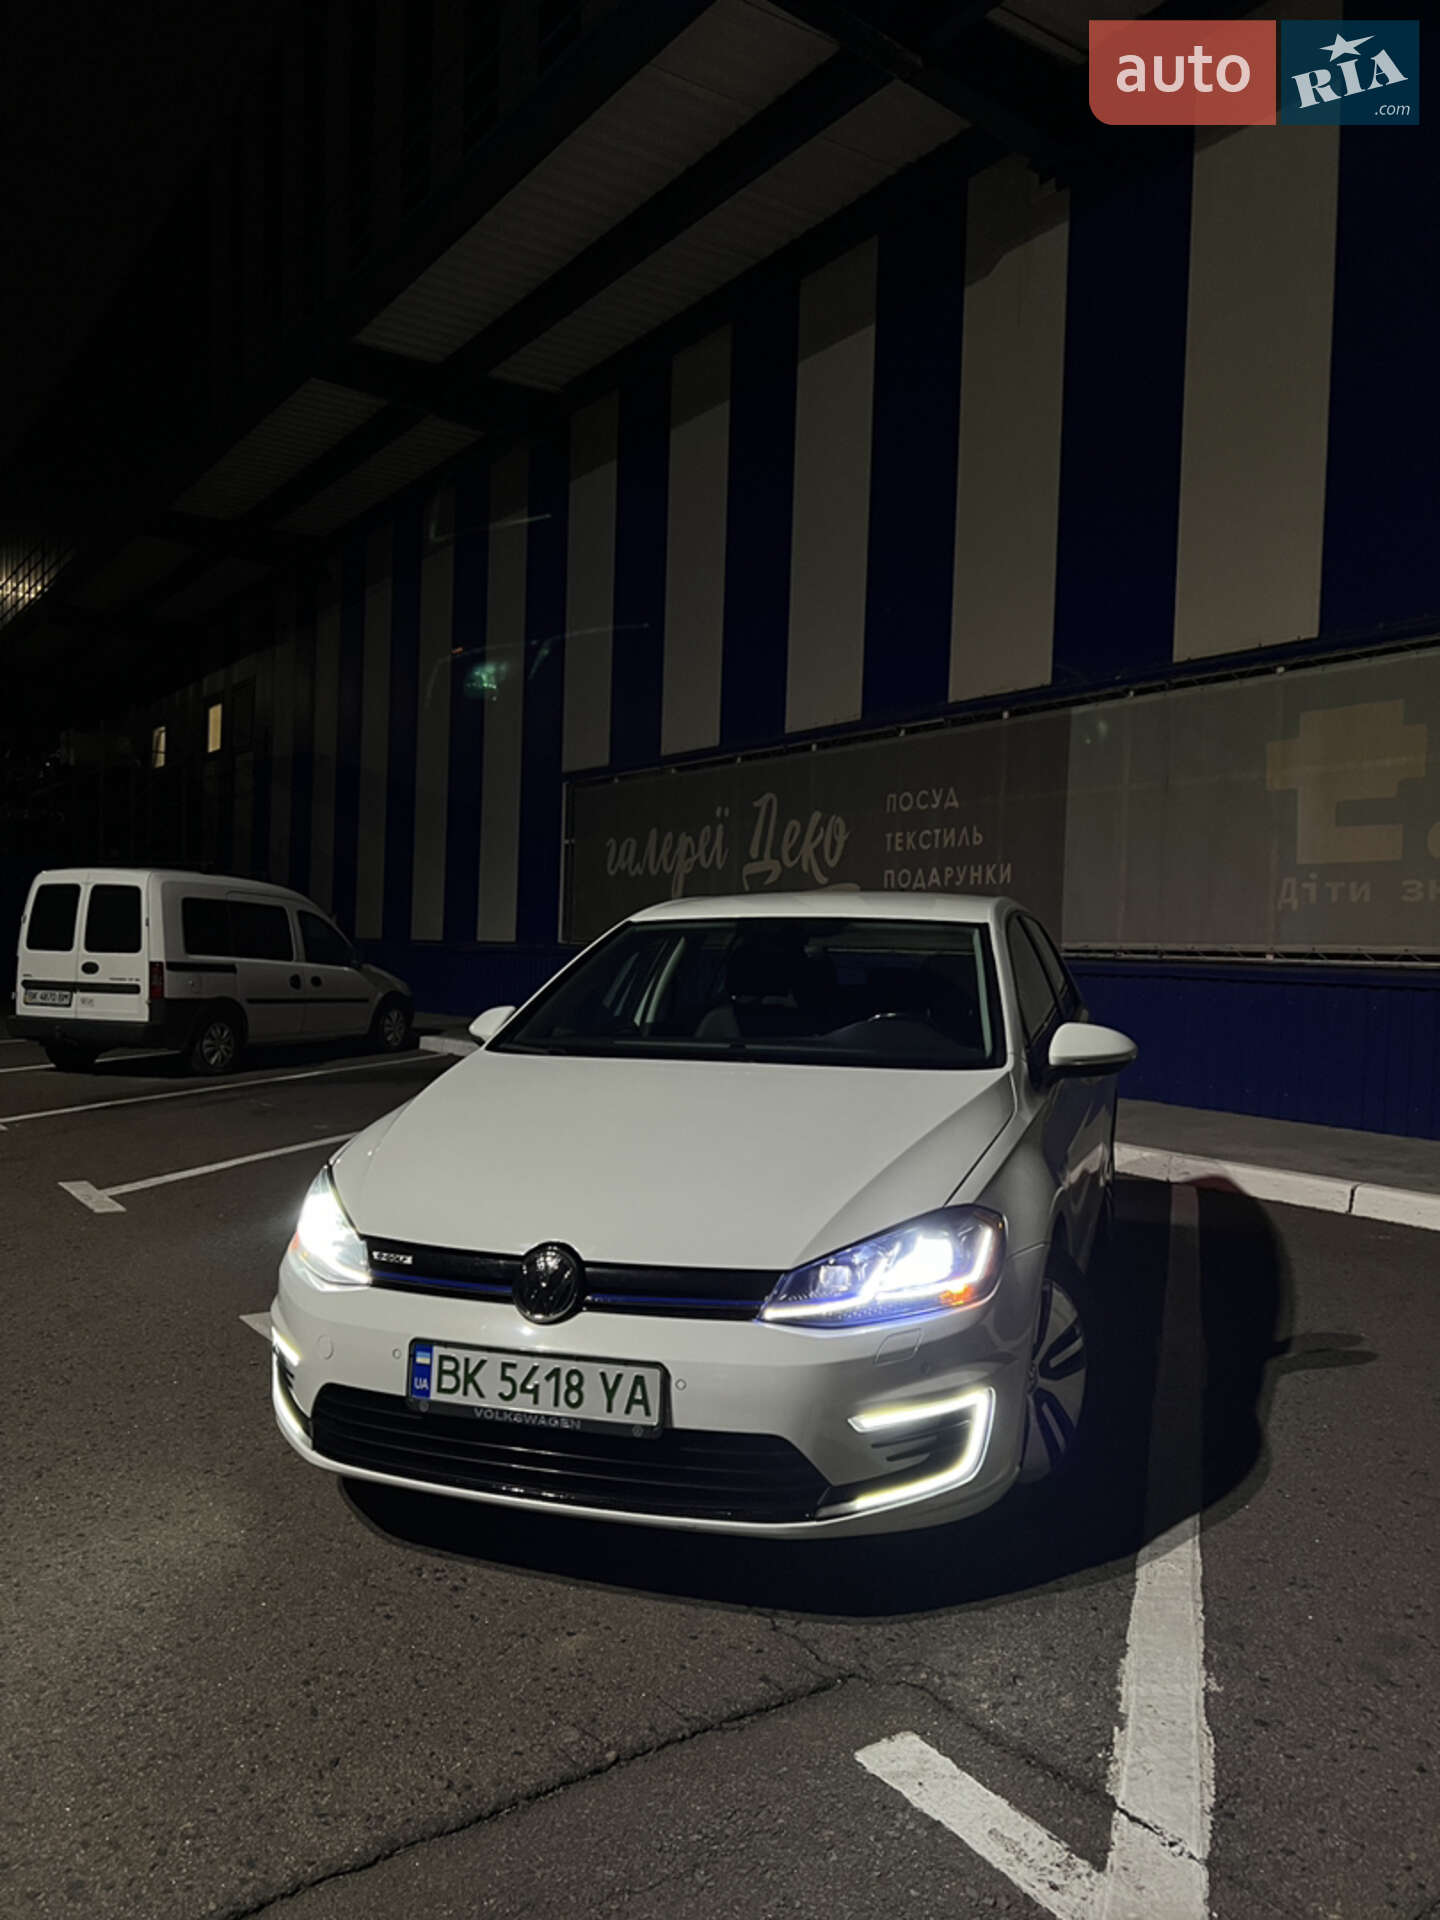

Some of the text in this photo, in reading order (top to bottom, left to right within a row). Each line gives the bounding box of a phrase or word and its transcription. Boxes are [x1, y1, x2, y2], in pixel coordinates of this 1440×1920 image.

[886, 786, 959, 813] ПОСУД
[606, 791, 850, 899] галереї Деко
[884, 825, 984, 852] ТЕКСТИЛЬ
[883, 863, 1012, 890] ПОДАРУНКИ
[1277, 872, 1371, 912] Діти
[414, 1377, 429, 1390] UA
[436, 1354, 651, 1417] BK 5418 YA
[473, 1407, 582, 1430] VOLKSWAGEN
